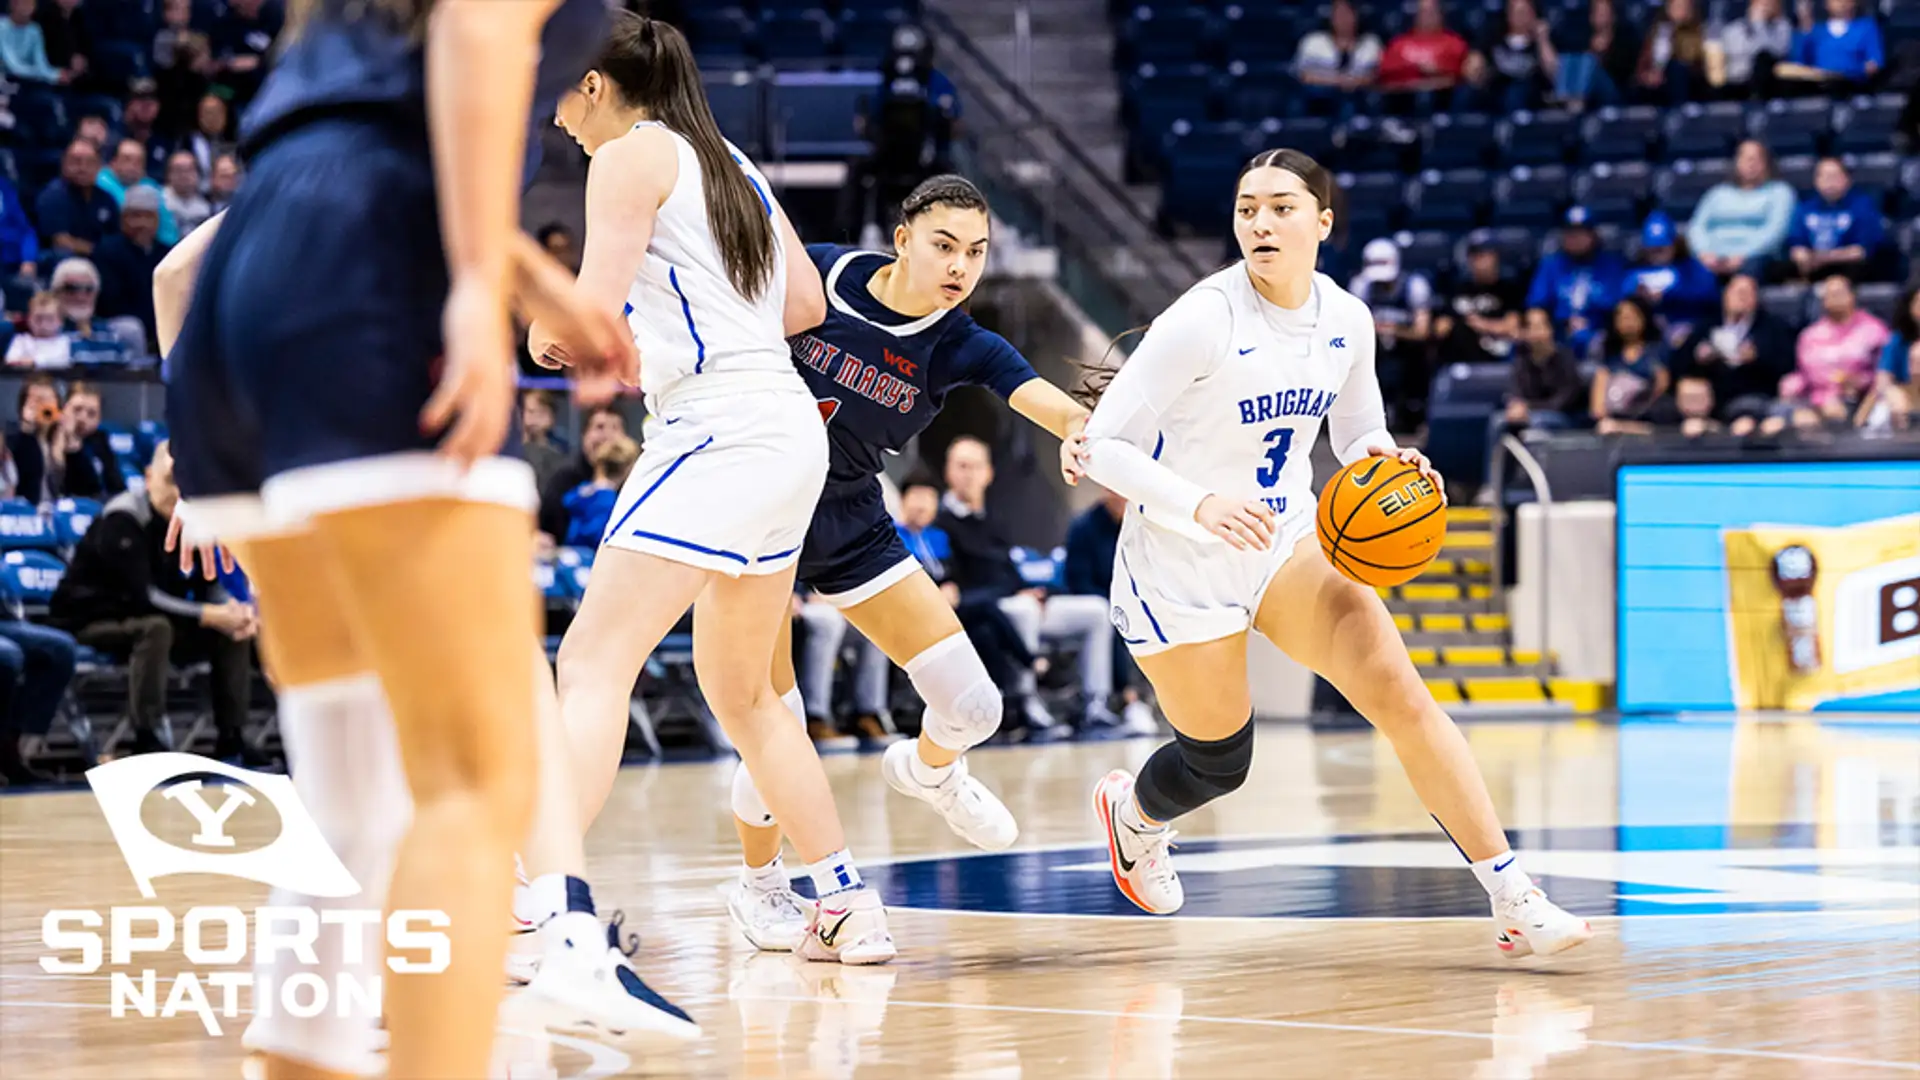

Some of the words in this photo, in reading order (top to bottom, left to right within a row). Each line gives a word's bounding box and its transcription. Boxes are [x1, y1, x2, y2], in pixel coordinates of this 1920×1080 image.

[833, 352, 921, 413] MARY'S
[883, 347, 919, 377] WCC
[1256, 427, 1295, 489] 3
[1377, 476, 1435, 518] ELITE
